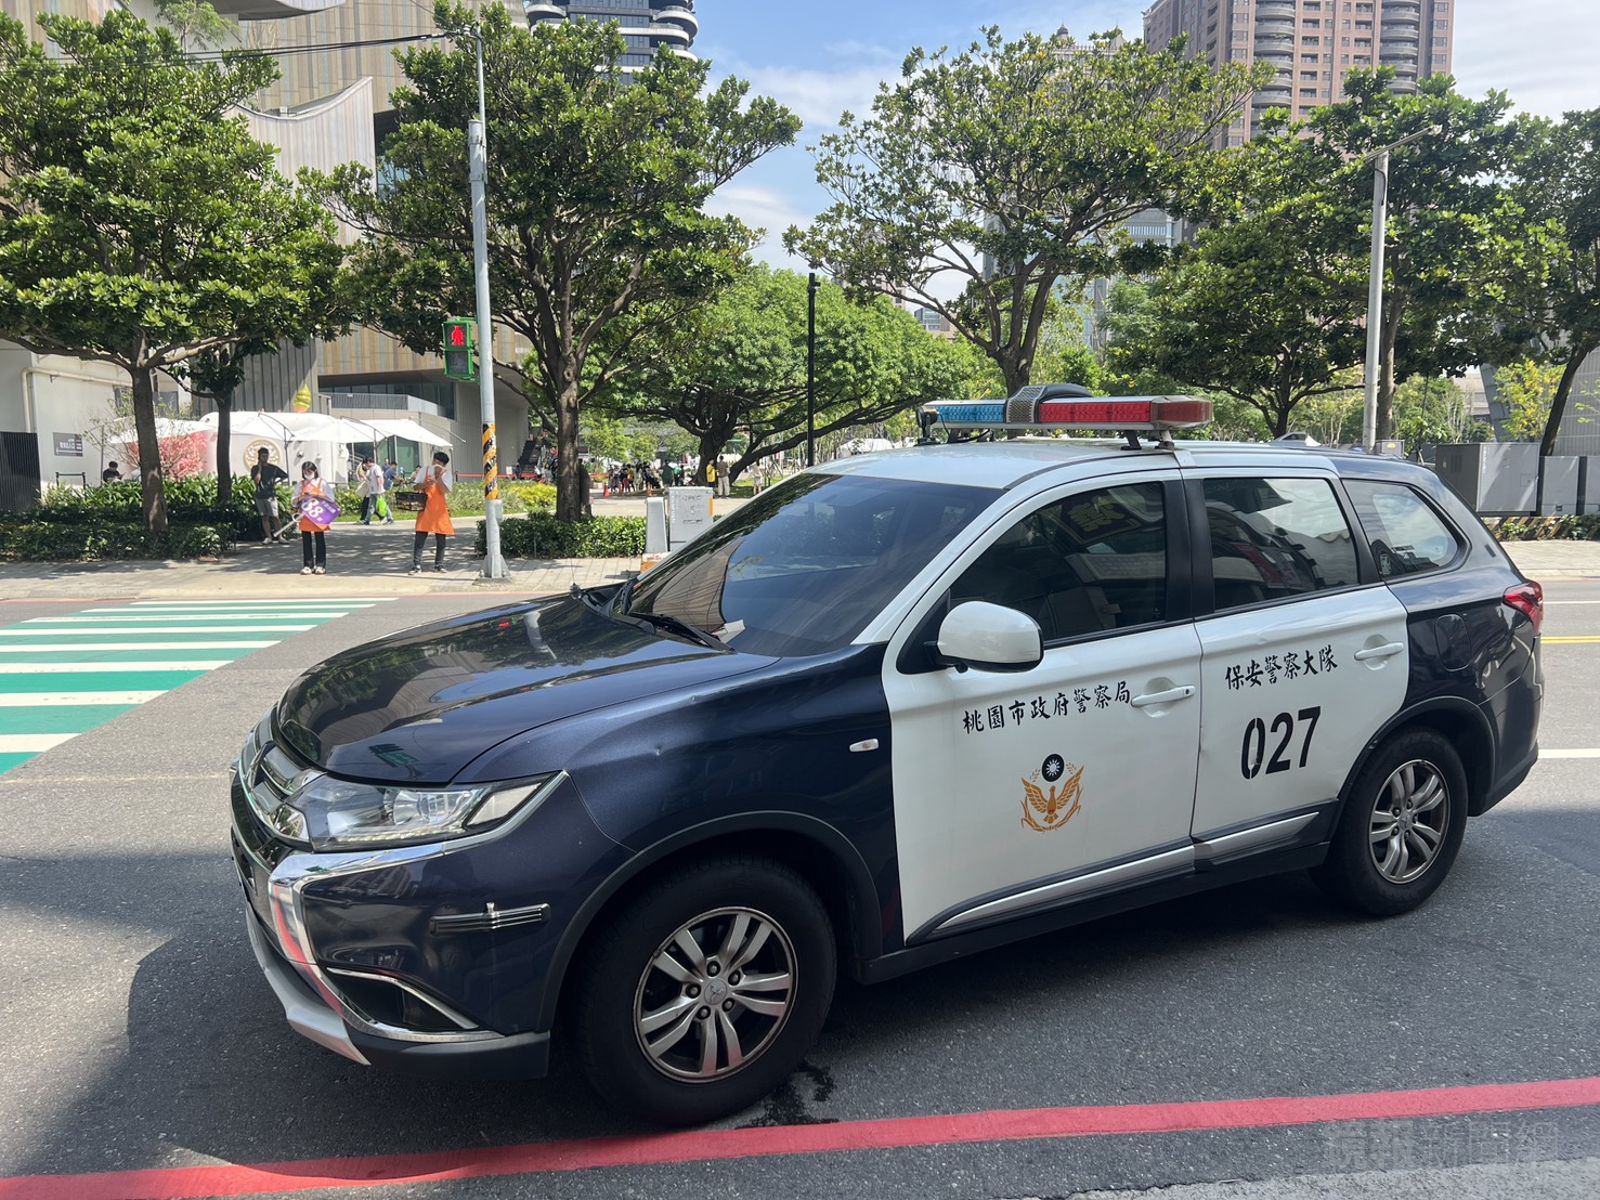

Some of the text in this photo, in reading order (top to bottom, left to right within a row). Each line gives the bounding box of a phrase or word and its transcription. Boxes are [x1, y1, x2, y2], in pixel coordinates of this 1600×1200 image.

[1225, 644, 1338, 690] 保安警察大隊
[963, 680, 1132, 735] 桃園市政府警察局
[1241, 706, 1321, 780] 027
